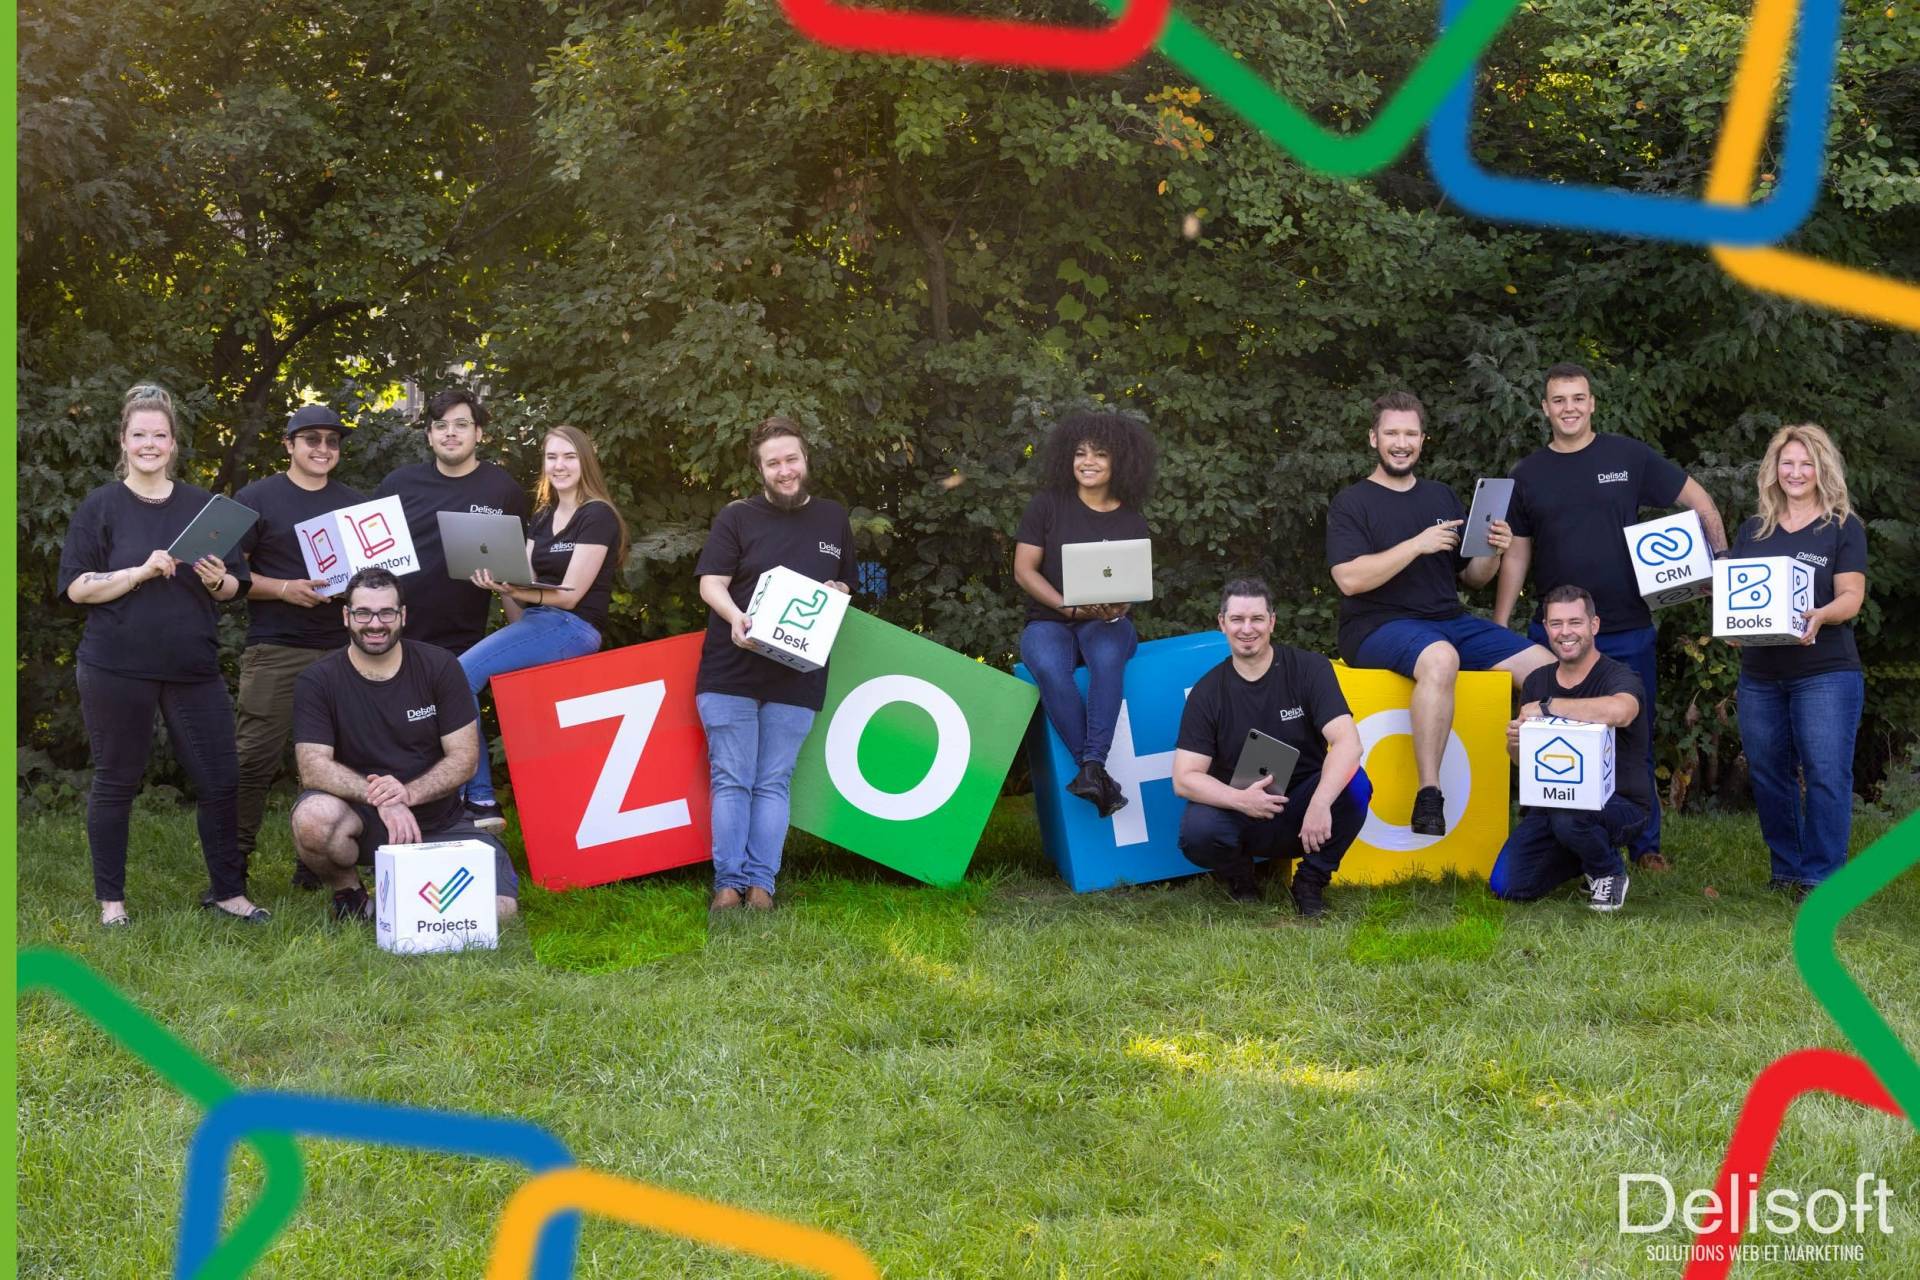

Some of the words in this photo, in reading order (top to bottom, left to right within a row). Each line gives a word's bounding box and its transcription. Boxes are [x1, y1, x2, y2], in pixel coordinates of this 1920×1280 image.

[1655, 565, 1692, 584] CRM
[1726, 614, 1773, 630] Books
[772, 626, 810, 653] Desk
[1543, 786, 1576, 801] Mail
[417, 918, 478, 935] Projects
